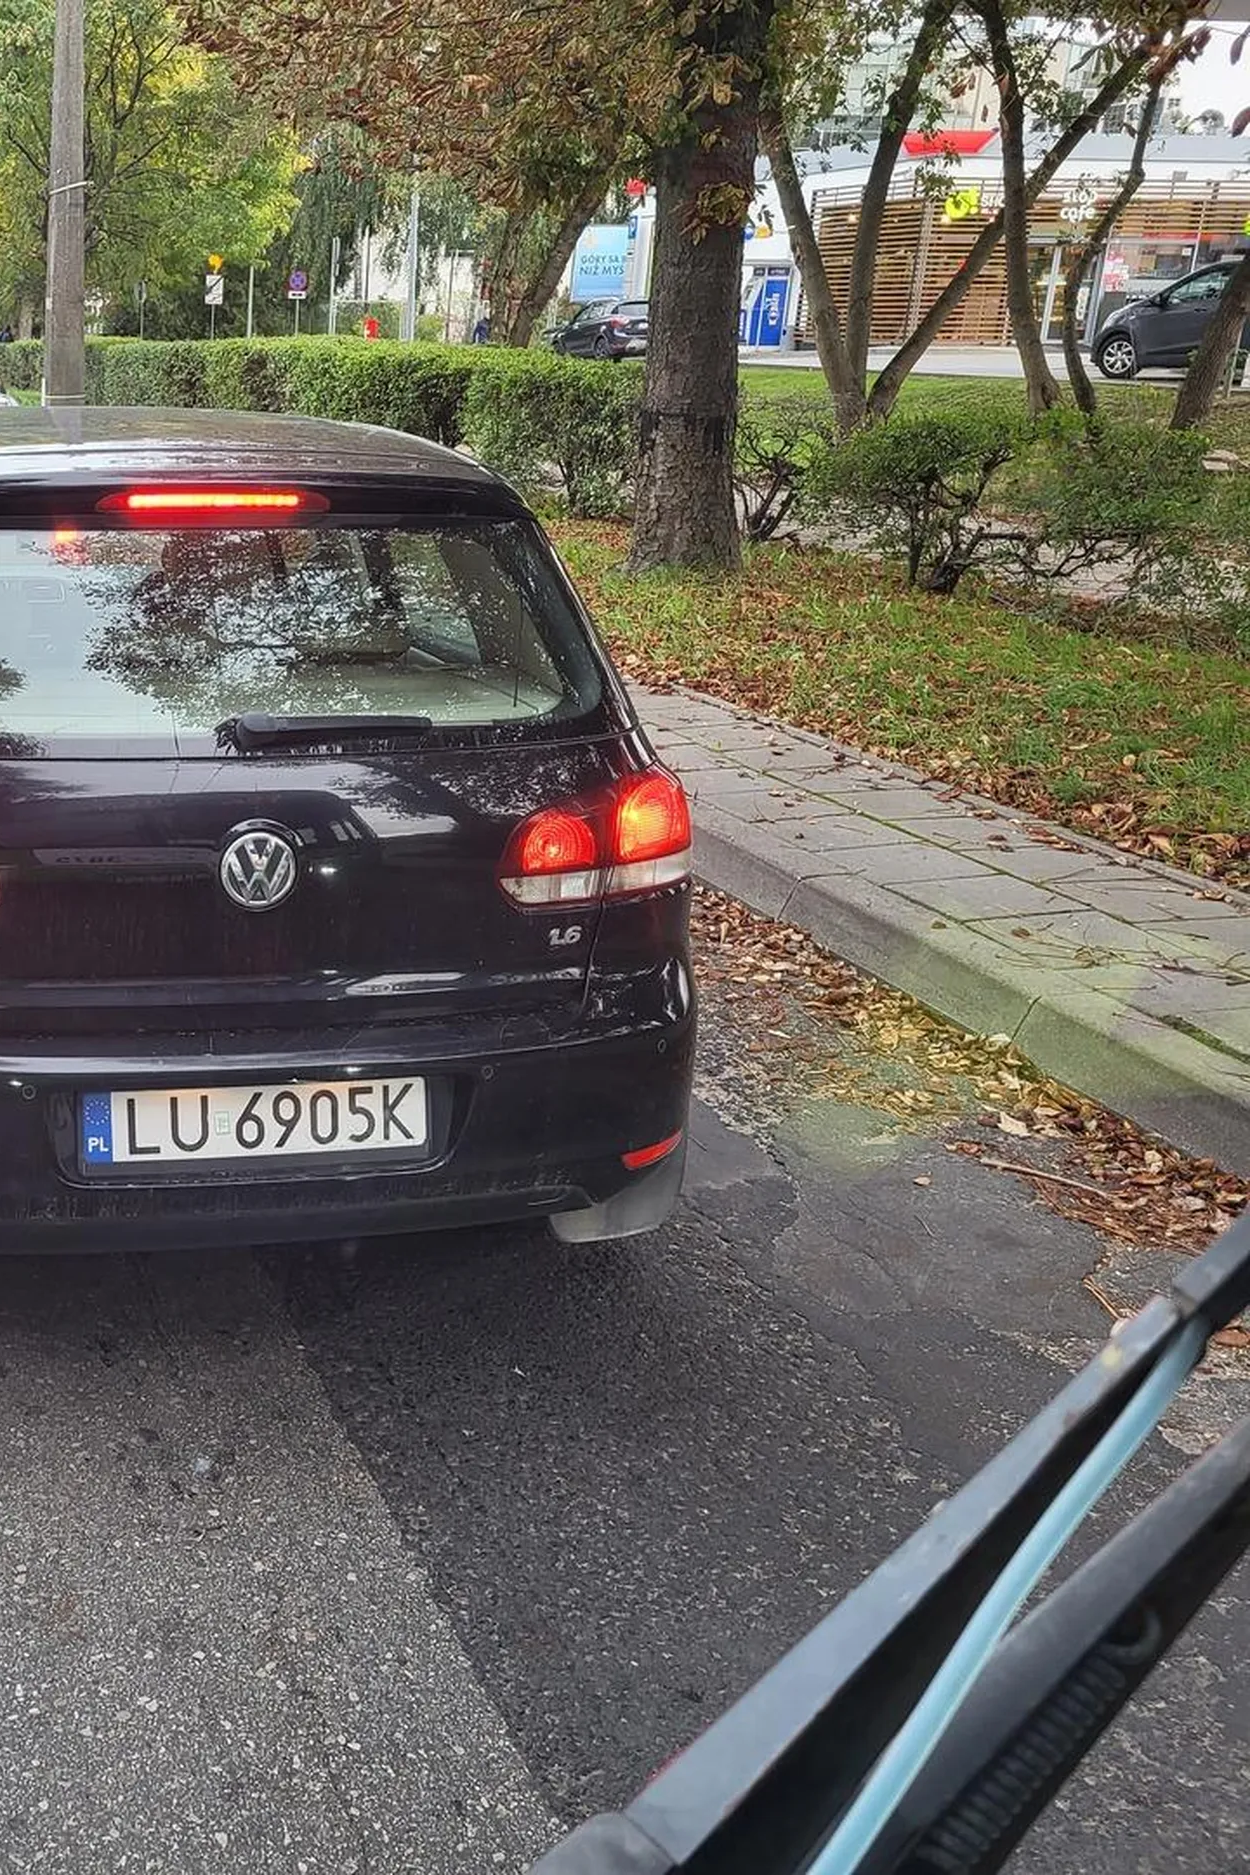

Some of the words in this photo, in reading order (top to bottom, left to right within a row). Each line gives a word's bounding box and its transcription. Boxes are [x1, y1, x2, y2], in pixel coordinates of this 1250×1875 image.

[1060, 204, 1095, 223] cafe
[126, 1095, 210, 1155] LU
[236, 1083, 414, 1150] 6905K
[88, 1137, 109, 1152] PL
